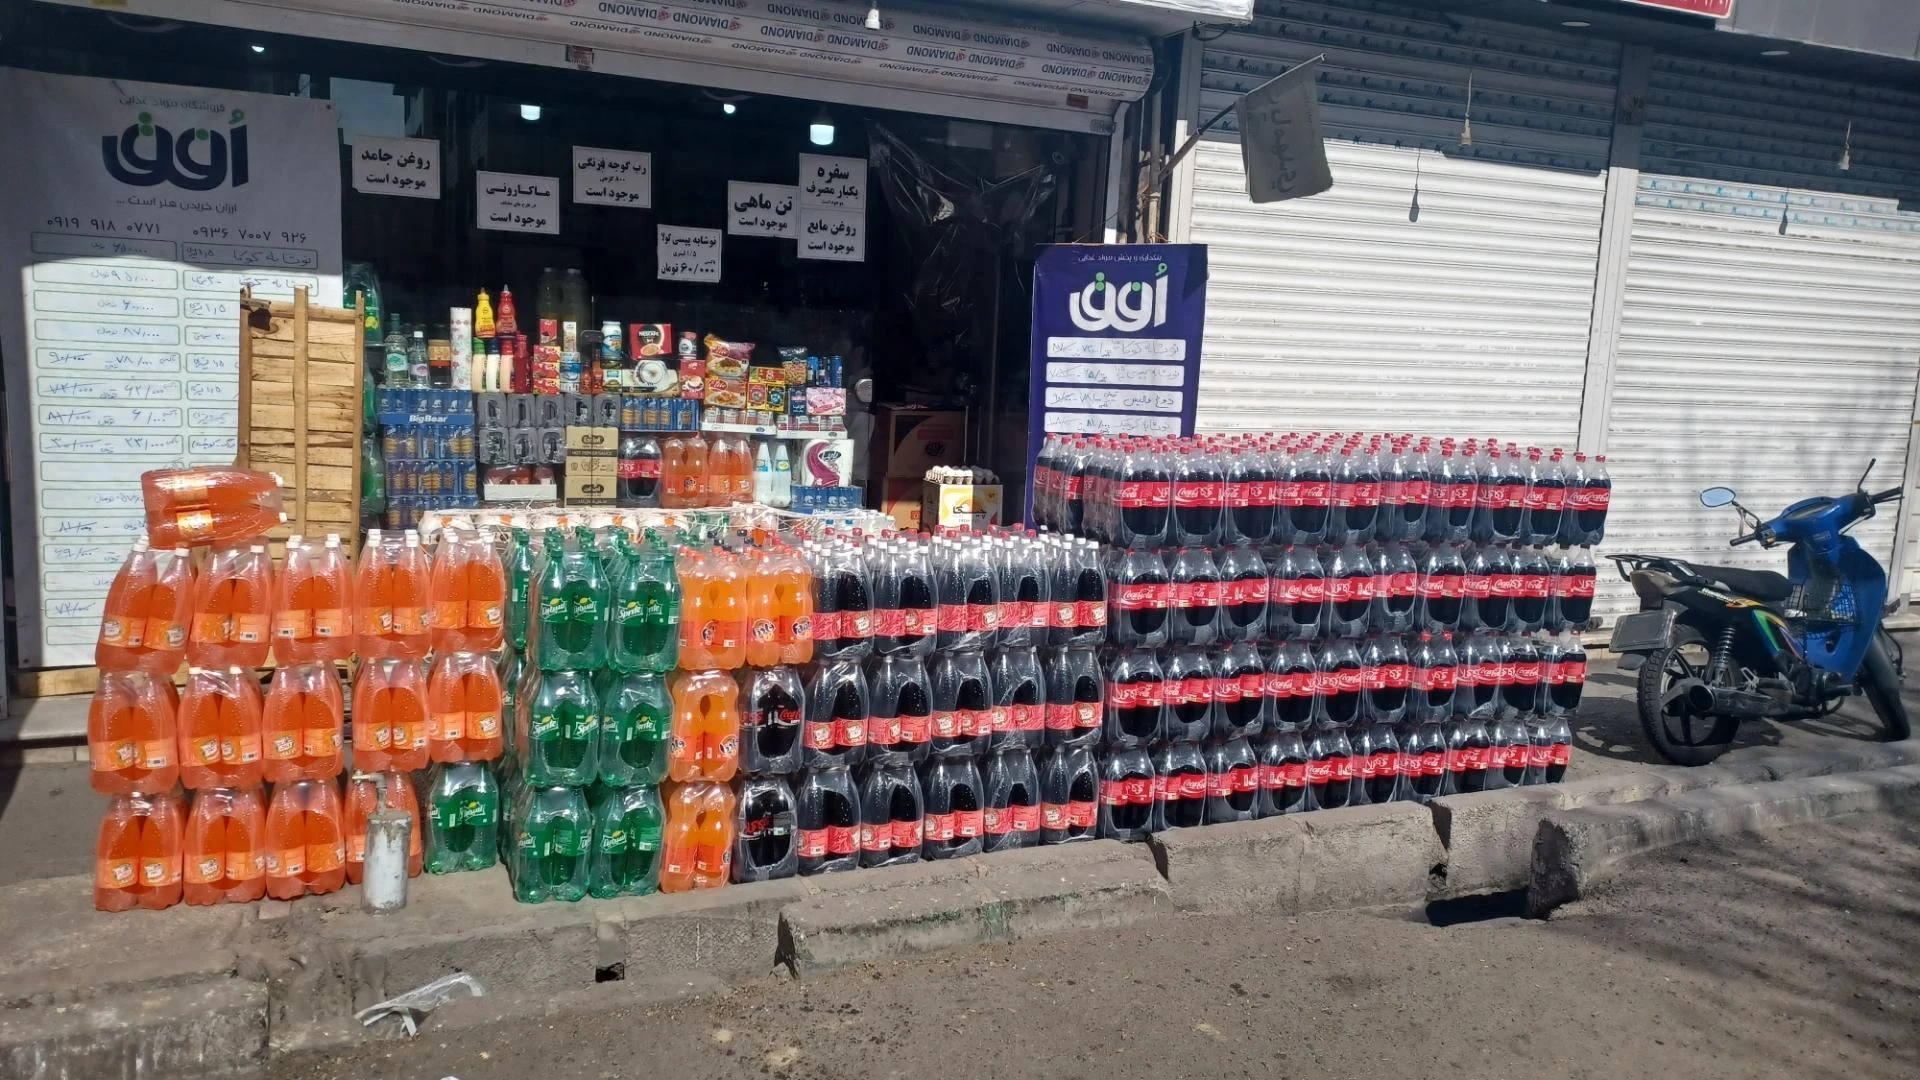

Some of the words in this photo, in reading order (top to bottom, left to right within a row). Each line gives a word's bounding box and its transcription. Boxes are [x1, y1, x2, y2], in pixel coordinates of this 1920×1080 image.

[599, 2, 658, 19] DIAMOND
[673, 12, 729, 30] DIAMOND
[760, 25, 814, 42] DIAMOND
[827, 33, 880, 50] DIAMOND
[907, 45, 956, 62] DIAMOND
[969, 53, 1017, 69] DIAMOND
[1041, 63, 1087, 78] DIAMOND
[361, 149, 393, 166] جامد
[397, 153, 431, 170] روغن
[632, 161, 647, 175] رب
[817, 162, 850, 183] سفره
[366, 173, 390, 184] است
[392, 176, 426, 190] موجود
[485, 182, 550, 197] ماکارونی
[585, 185, 607, 198] است
[607, 188, 640, 201] موجود
[806, 183, 836, 197] مصرف
[127, 195, 156, 206] است
[159, 198, 178, 209] هنر
[180, 200, 213, 213] خریدن
[734, 192, 772, 213] ماهی
[775, 193, 793, 216] تن
[215, 203, 238, 214] ارزان
[489, 212, 512, 223] است
[514, 215, 546, 229] موجود
[738, 215, 759, 227] است
[47, 216, 80, 229] ۰۹۱۹
[90, 219, 116, 231] ۹۱۸
[127, 222, 160, 235] ۰۷۷۱
[759, 219, 788, 231] موجود
[807, 219, 830, 235] مایع
[831, 221, 857, 237] روغن
[193, 227, 229, 239] ۰۹۳۶
[238, 230, 271, 242] ۷۰۰۷
[281, 231, 307, 244] ۹۲۶
[692, 235, 717, 248] نوشابه
[807, 239, 828, 251] است
[827, 241, 855, 254] موجود
[661, 262, 679, 276] تومان
[680, 262, 715, 275] ۶۰/۰۰۰
[408, 413, 448, 424] BigBear
[618, 604, 644, 621] Sprite
[532, 719, 559, 738] Sprite
